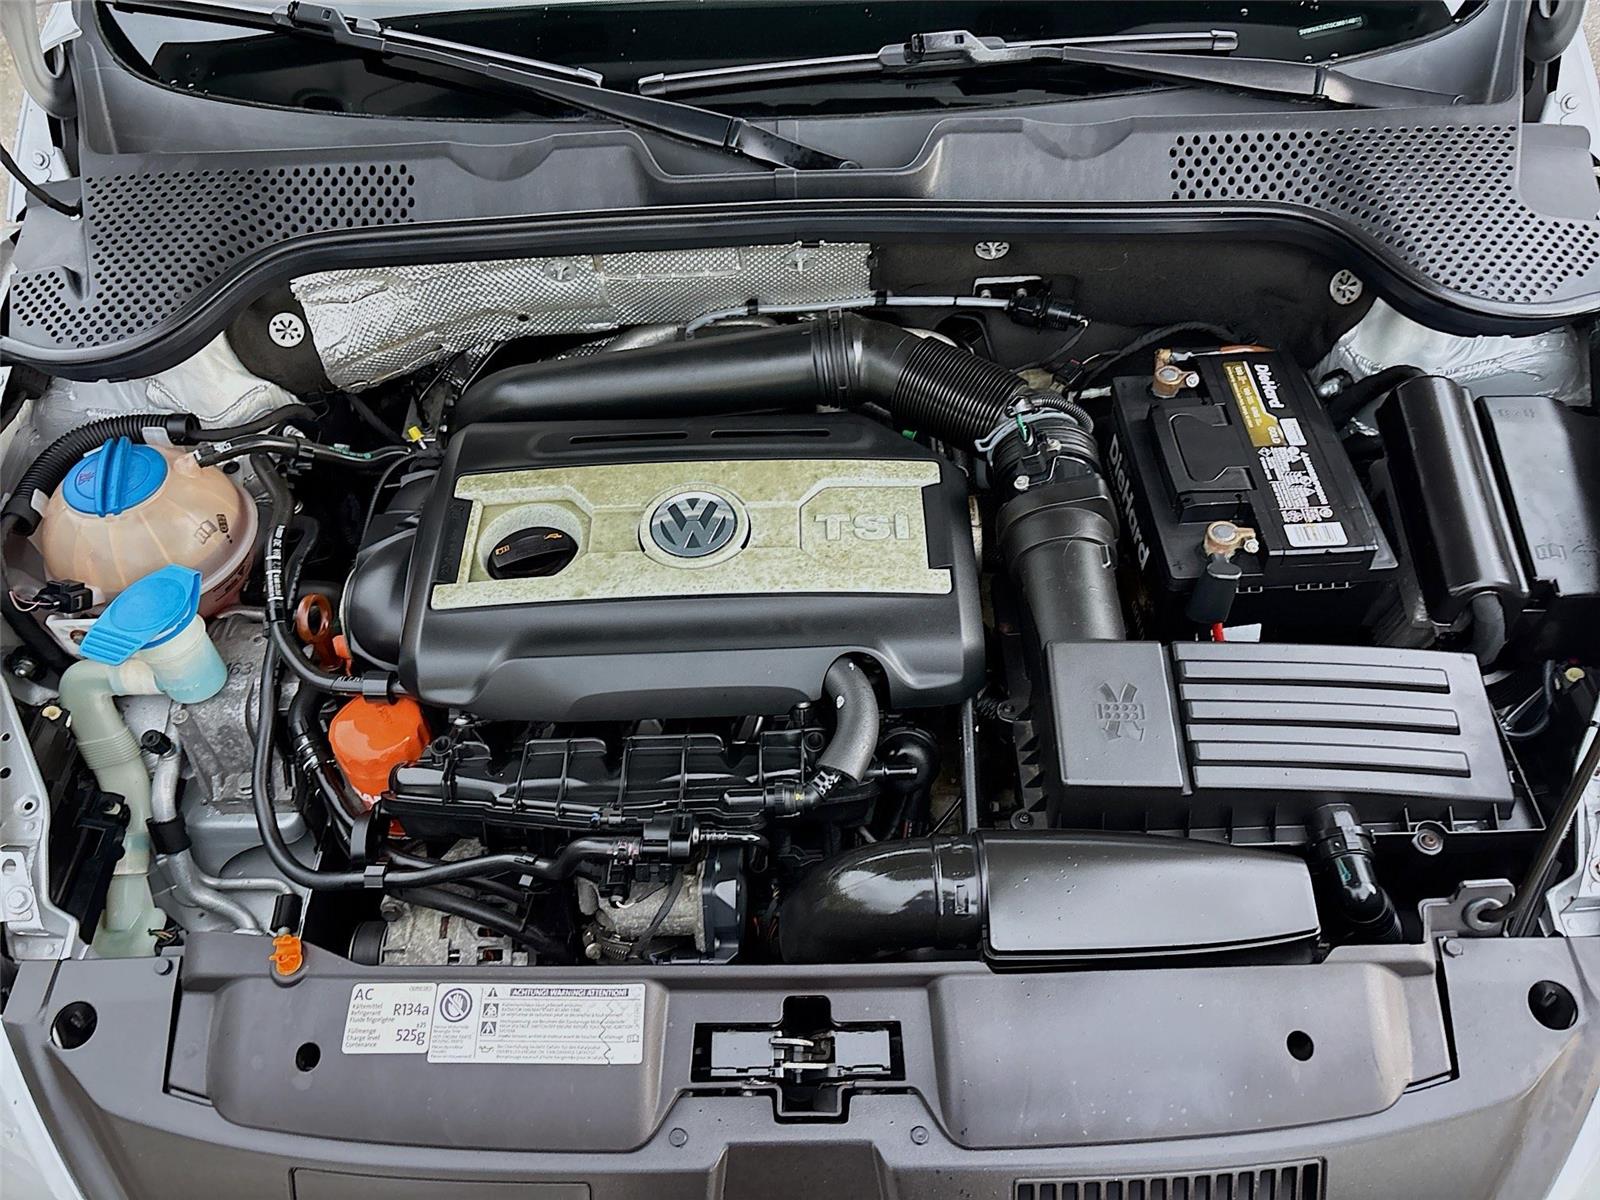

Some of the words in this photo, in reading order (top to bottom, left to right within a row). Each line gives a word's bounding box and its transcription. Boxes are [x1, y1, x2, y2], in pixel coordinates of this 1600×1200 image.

[1254, 364, 1284, 409] DieHard
[1109, 433, 1150, 570] DieHard
[814, 512, 910, 541] TSI
[354, 988, 374, 1000] AC
[512, 988, 548, 997] ACHTUNG!
[550, 988, 586, 997] WARNING!
[587, 988, 627, 997] ATTENTION!
[393, 1003, 429, 1016] R134a
[395, 1029, 426, 1046] 525g
